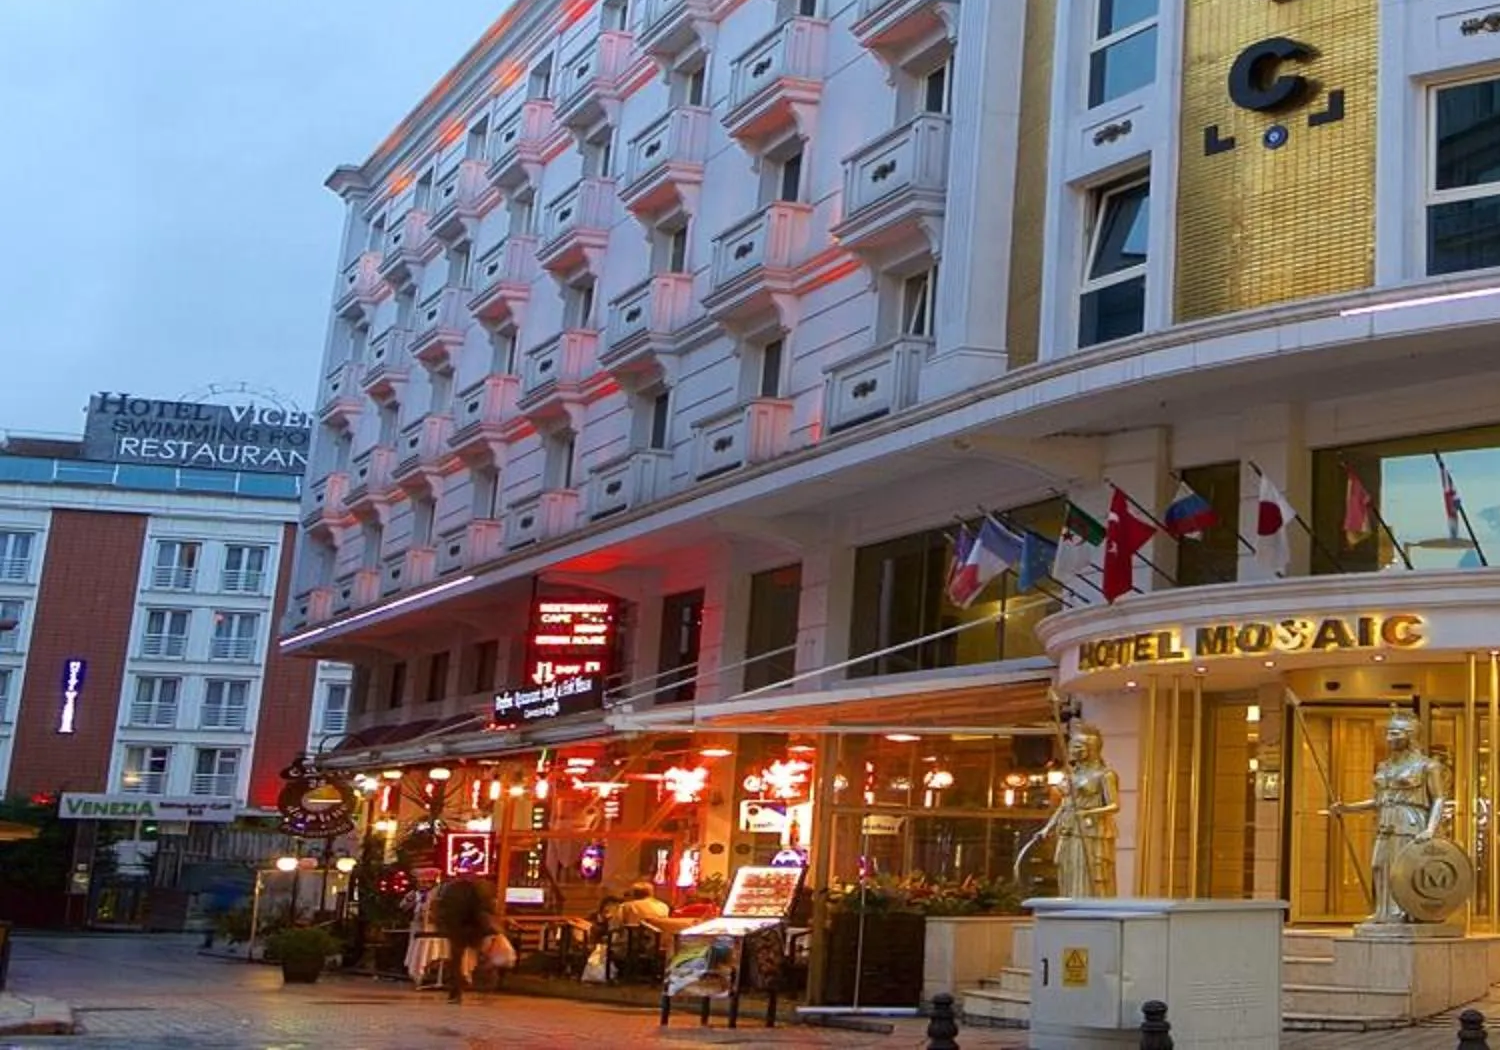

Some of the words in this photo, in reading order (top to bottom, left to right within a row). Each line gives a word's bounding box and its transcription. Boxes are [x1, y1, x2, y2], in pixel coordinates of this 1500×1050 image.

[95, 391, 211, 421] HOTEL
[112, 418, 259, 443] SWIMMING
[1079, 631, 1185, 670] HOTEL
[1196, 615, 1424, 656] MOSAIC
[66, 797, 155, 817] VENEZIA
